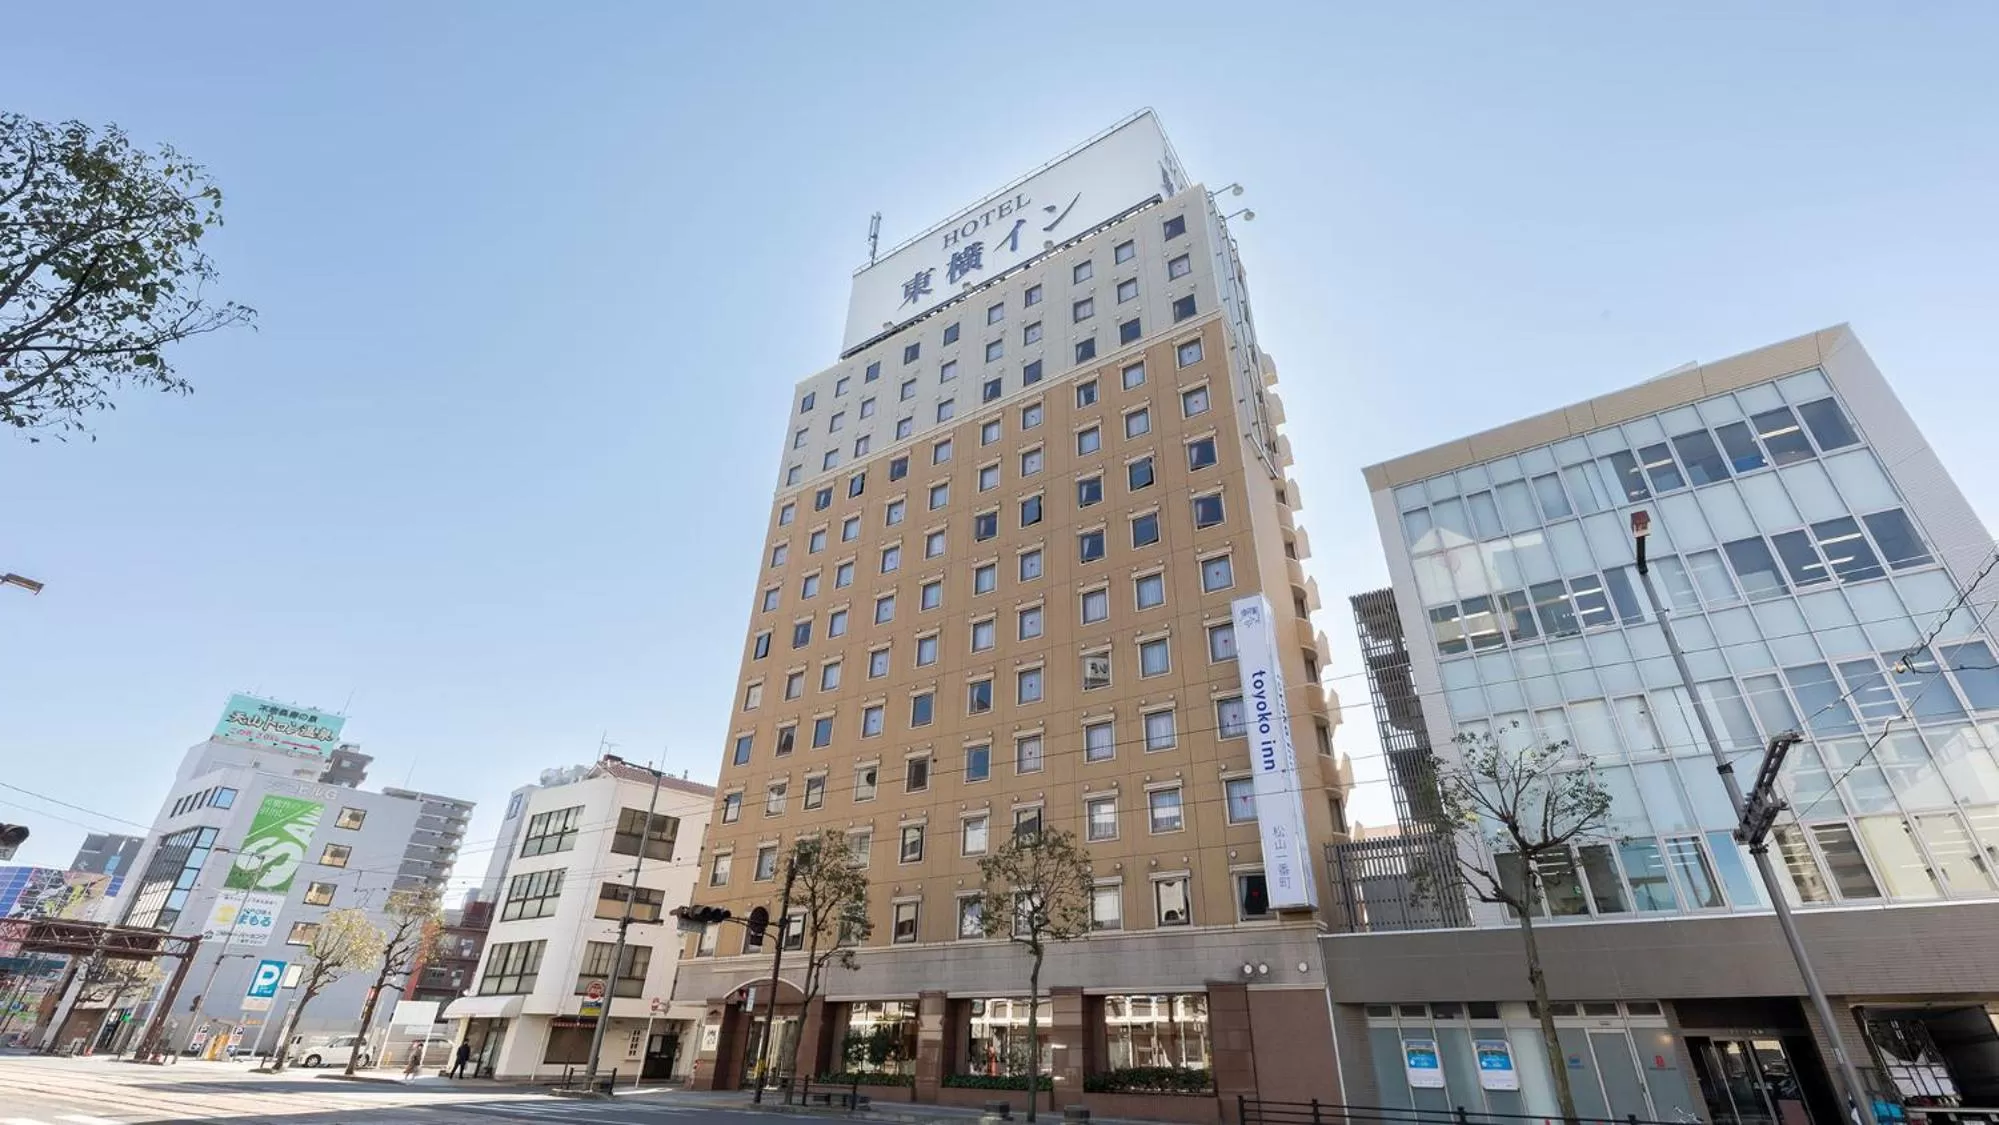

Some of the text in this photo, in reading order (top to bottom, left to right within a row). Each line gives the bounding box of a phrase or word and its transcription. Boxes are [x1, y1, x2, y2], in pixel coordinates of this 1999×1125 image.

[897, 191, 1081, 311] 東横イン
[942, 193, 1031, 250] HOTEL
[1252, 670, 1276, 770] toyoko inn
[250, 964, 280, 994] P
